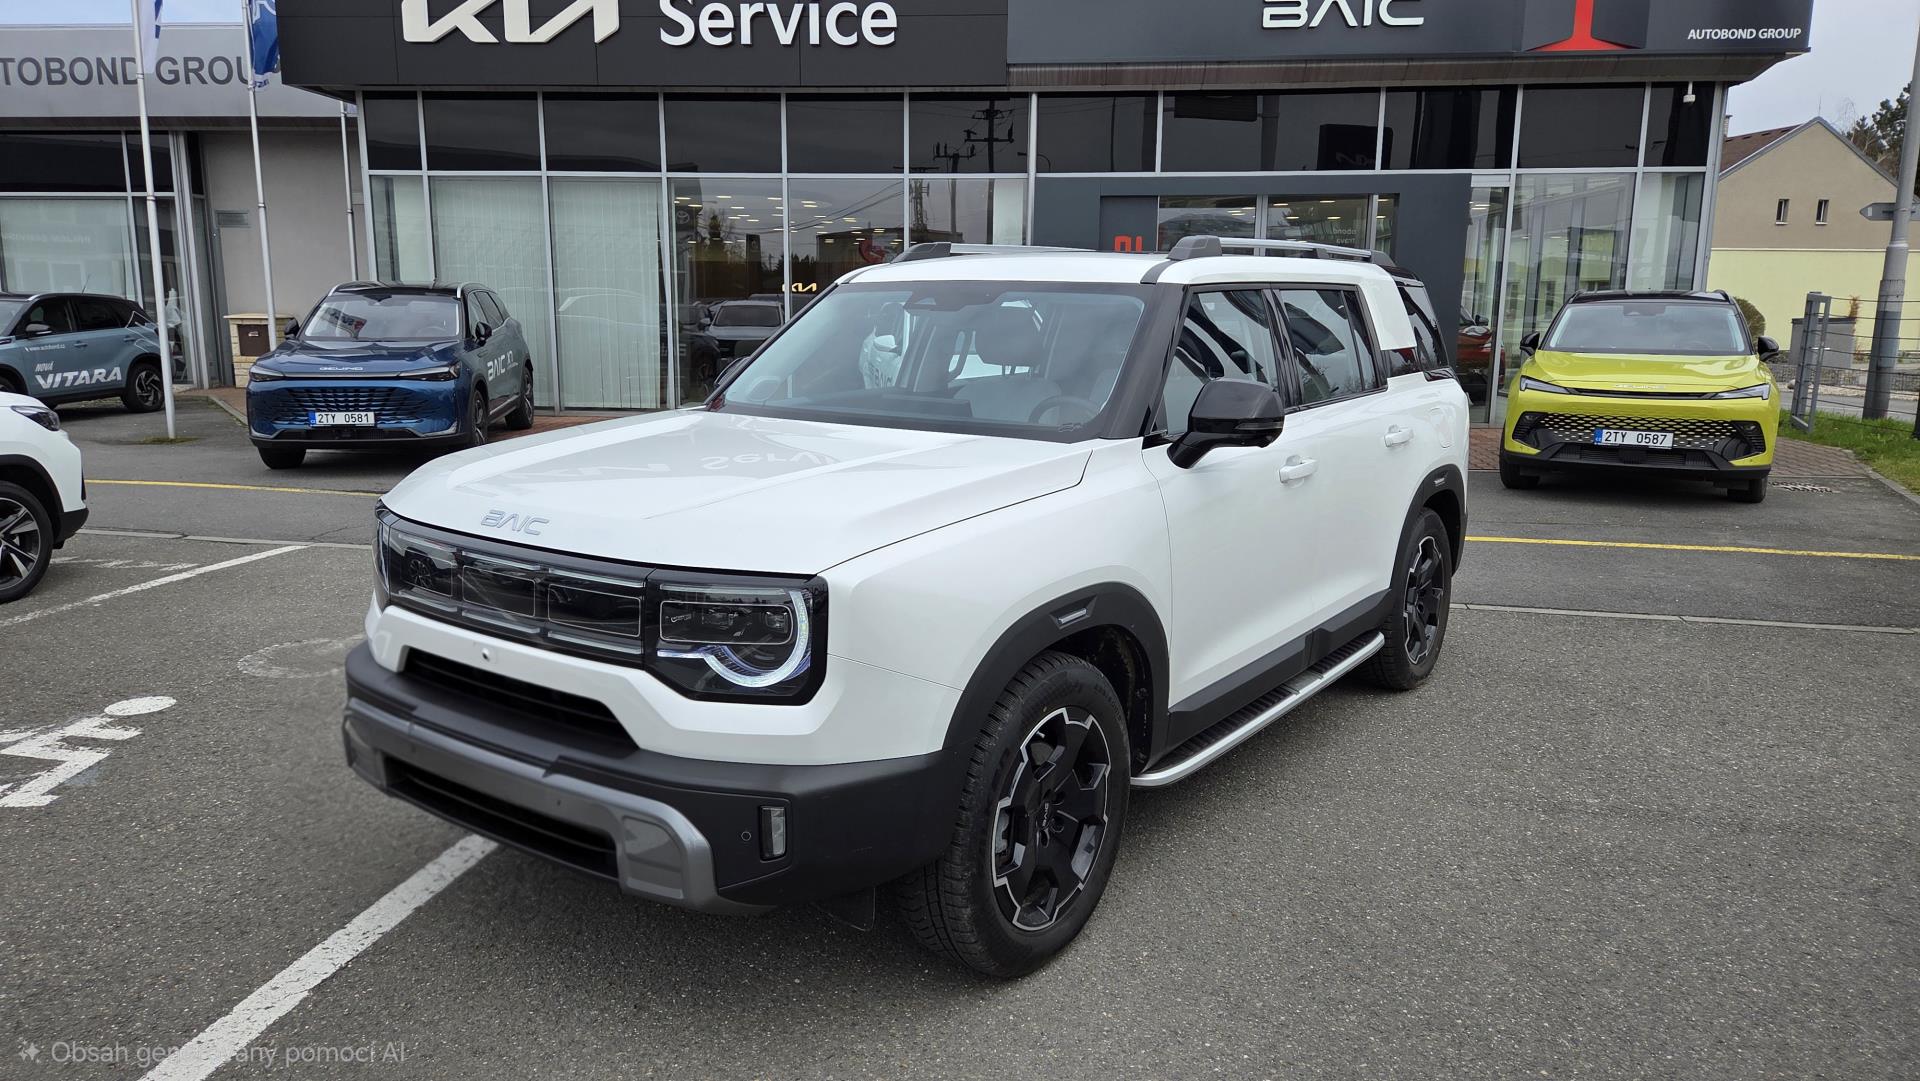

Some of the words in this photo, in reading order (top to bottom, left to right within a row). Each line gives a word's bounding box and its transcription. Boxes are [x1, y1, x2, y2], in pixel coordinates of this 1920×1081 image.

[401, 0, 620, 43] KIA
[660, 0, 898, 46] Service
[1262, 0, 1425, 28] BAIC
[1687, 28, 1756, 40] AUTOBOND
[1758, 28, 1802, 40] GROUP
[35, 366, 122, 389] VITARA
[318, 413, 336, 424] 2TY
[344, 413, 369, 423] 0581
[1604, 431, 1627, 443] 2TY
[1636, 433, 1667, 445] 0587
[481, 509, 550, 536] BAIC
